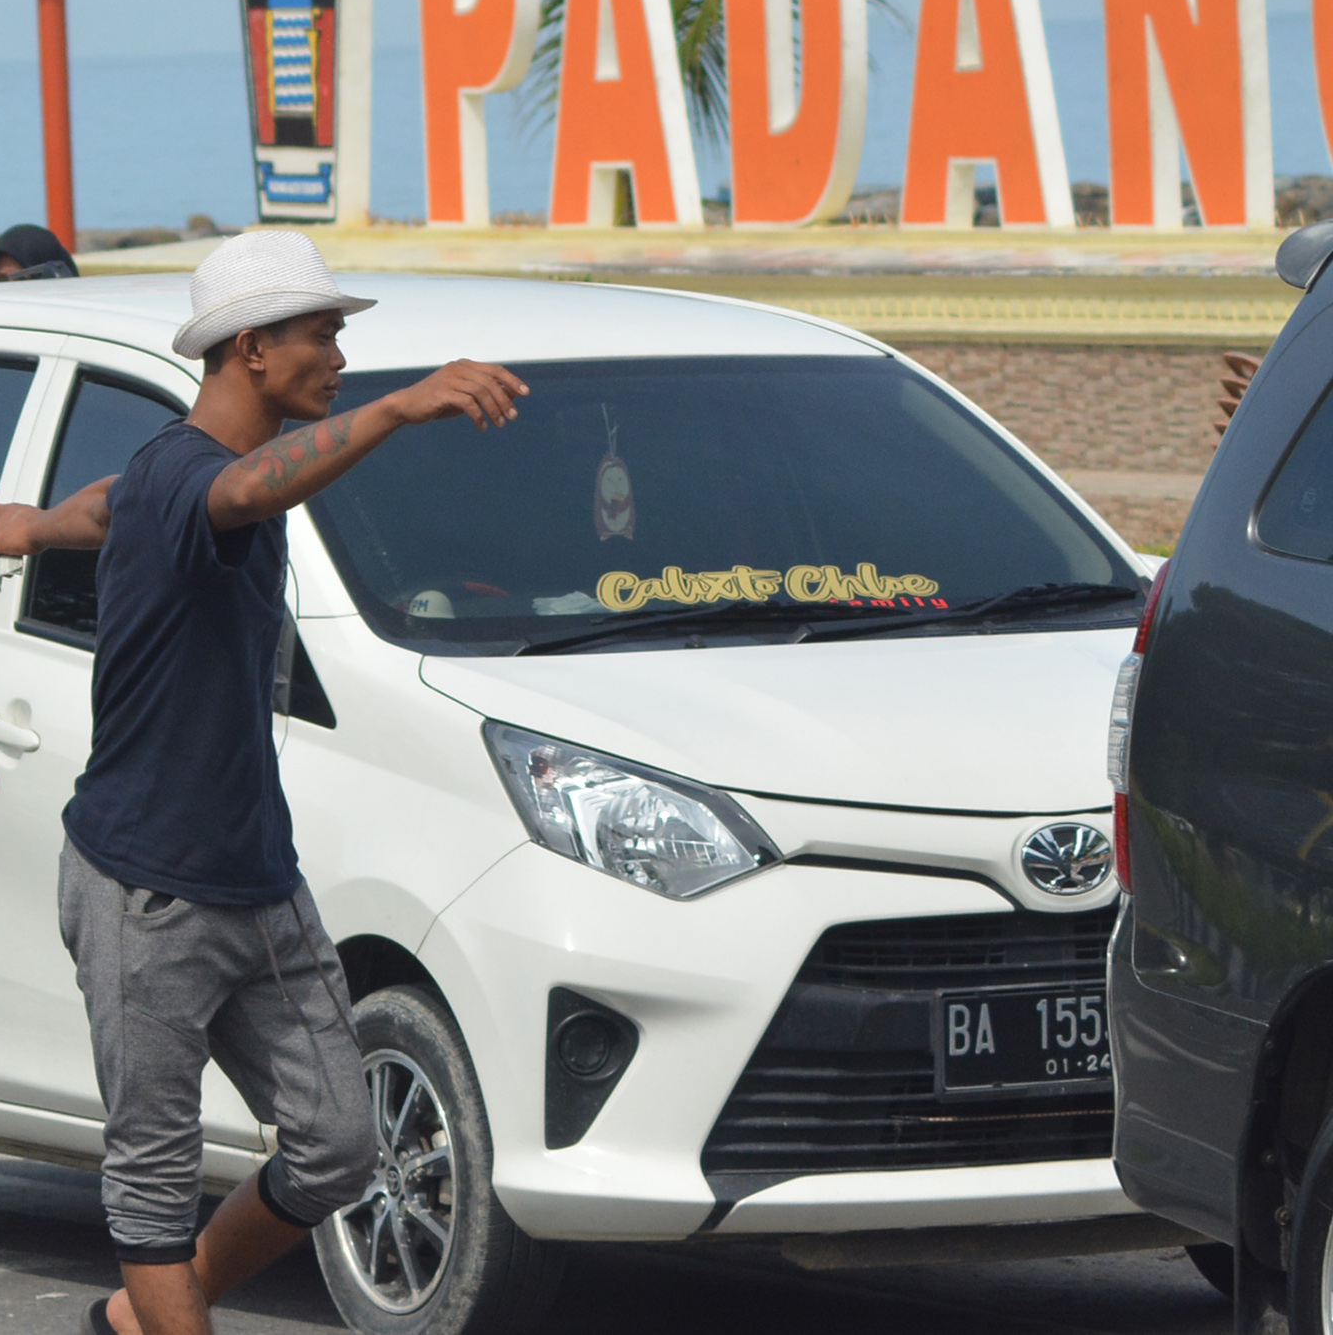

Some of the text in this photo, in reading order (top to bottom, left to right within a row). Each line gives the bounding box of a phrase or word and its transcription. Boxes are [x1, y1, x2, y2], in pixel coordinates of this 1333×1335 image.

[785, 562, 939, 602] Chloe
[949, 996, 1109, 1056] BA 155
